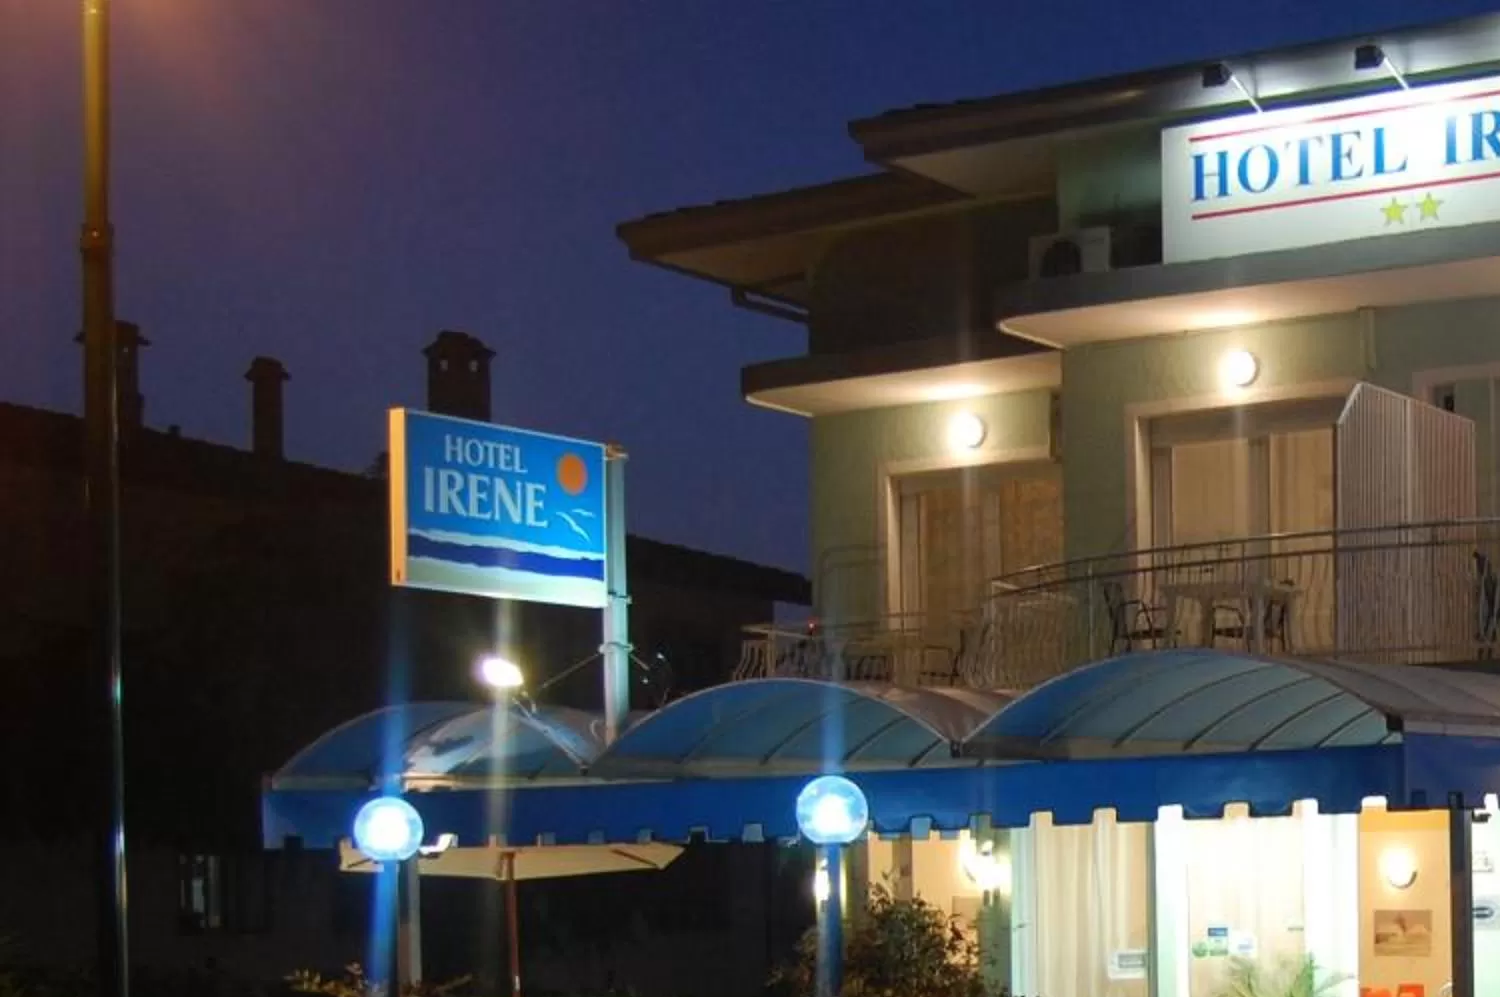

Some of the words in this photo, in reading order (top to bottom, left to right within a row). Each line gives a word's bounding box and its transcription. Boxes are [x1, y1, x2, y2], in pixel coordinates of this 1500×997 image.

[1191, 125, 1409, 200] HOTEL
[444, 433, 528, 474] HOTEL
[425, 467, 548, 528] IRENE
